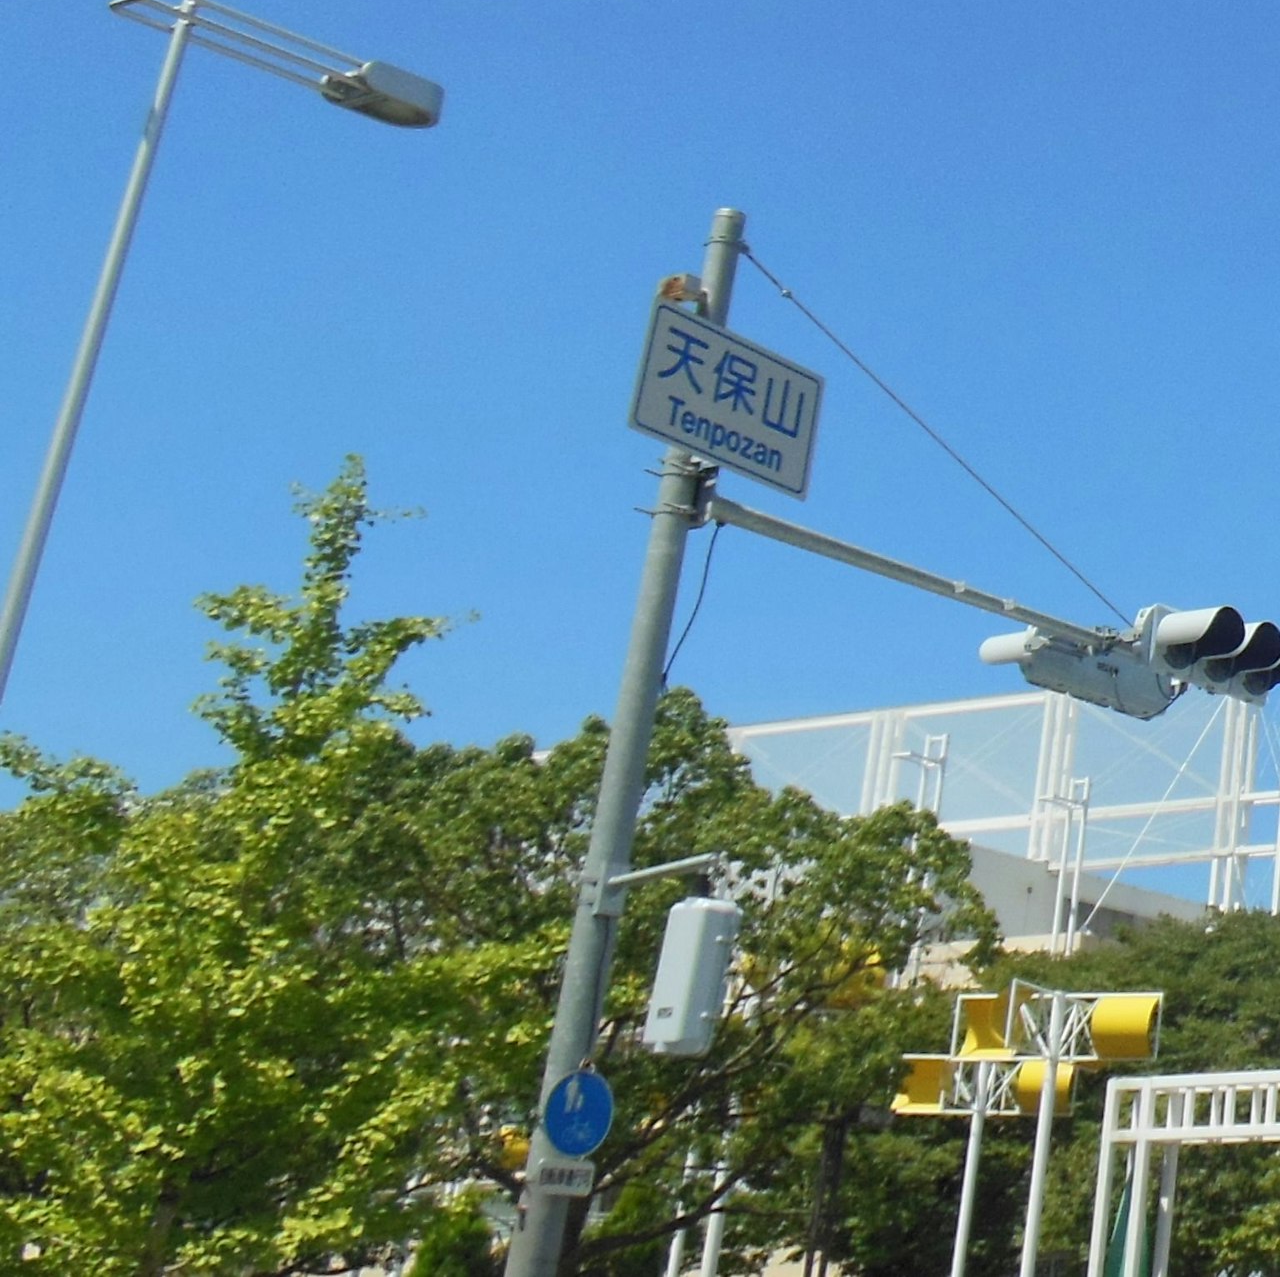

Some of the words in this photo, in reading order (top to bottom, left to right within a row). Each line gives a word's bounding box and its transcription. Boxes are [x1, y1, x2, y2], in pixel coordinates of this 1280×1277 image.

[657, 325, 804, 439] 天保山
[667, 395, 782, 472] Tenpozan
